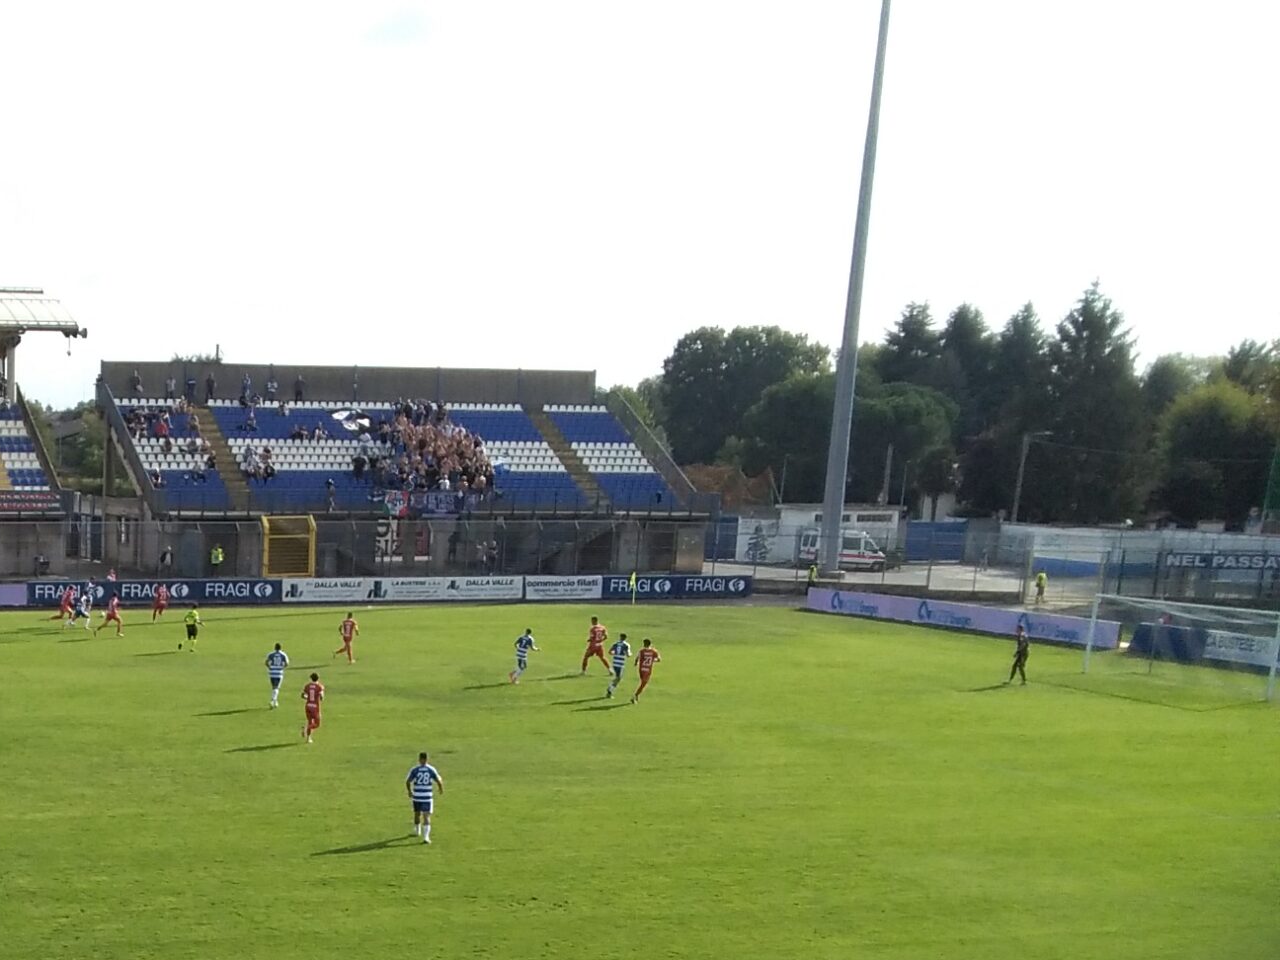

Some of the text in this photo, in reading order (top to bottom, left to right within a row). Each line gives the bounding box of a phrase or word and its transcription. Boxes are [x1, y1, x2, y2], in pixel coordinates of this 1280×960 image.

[1166, 554, 1206, 567] NEL
[205, 582, 250, 597] FRAGI
[609, 579, 651, 593] FRAGI
[685, 578, 726, 592] FRAGI
[417, 772, 430, 785] 28
